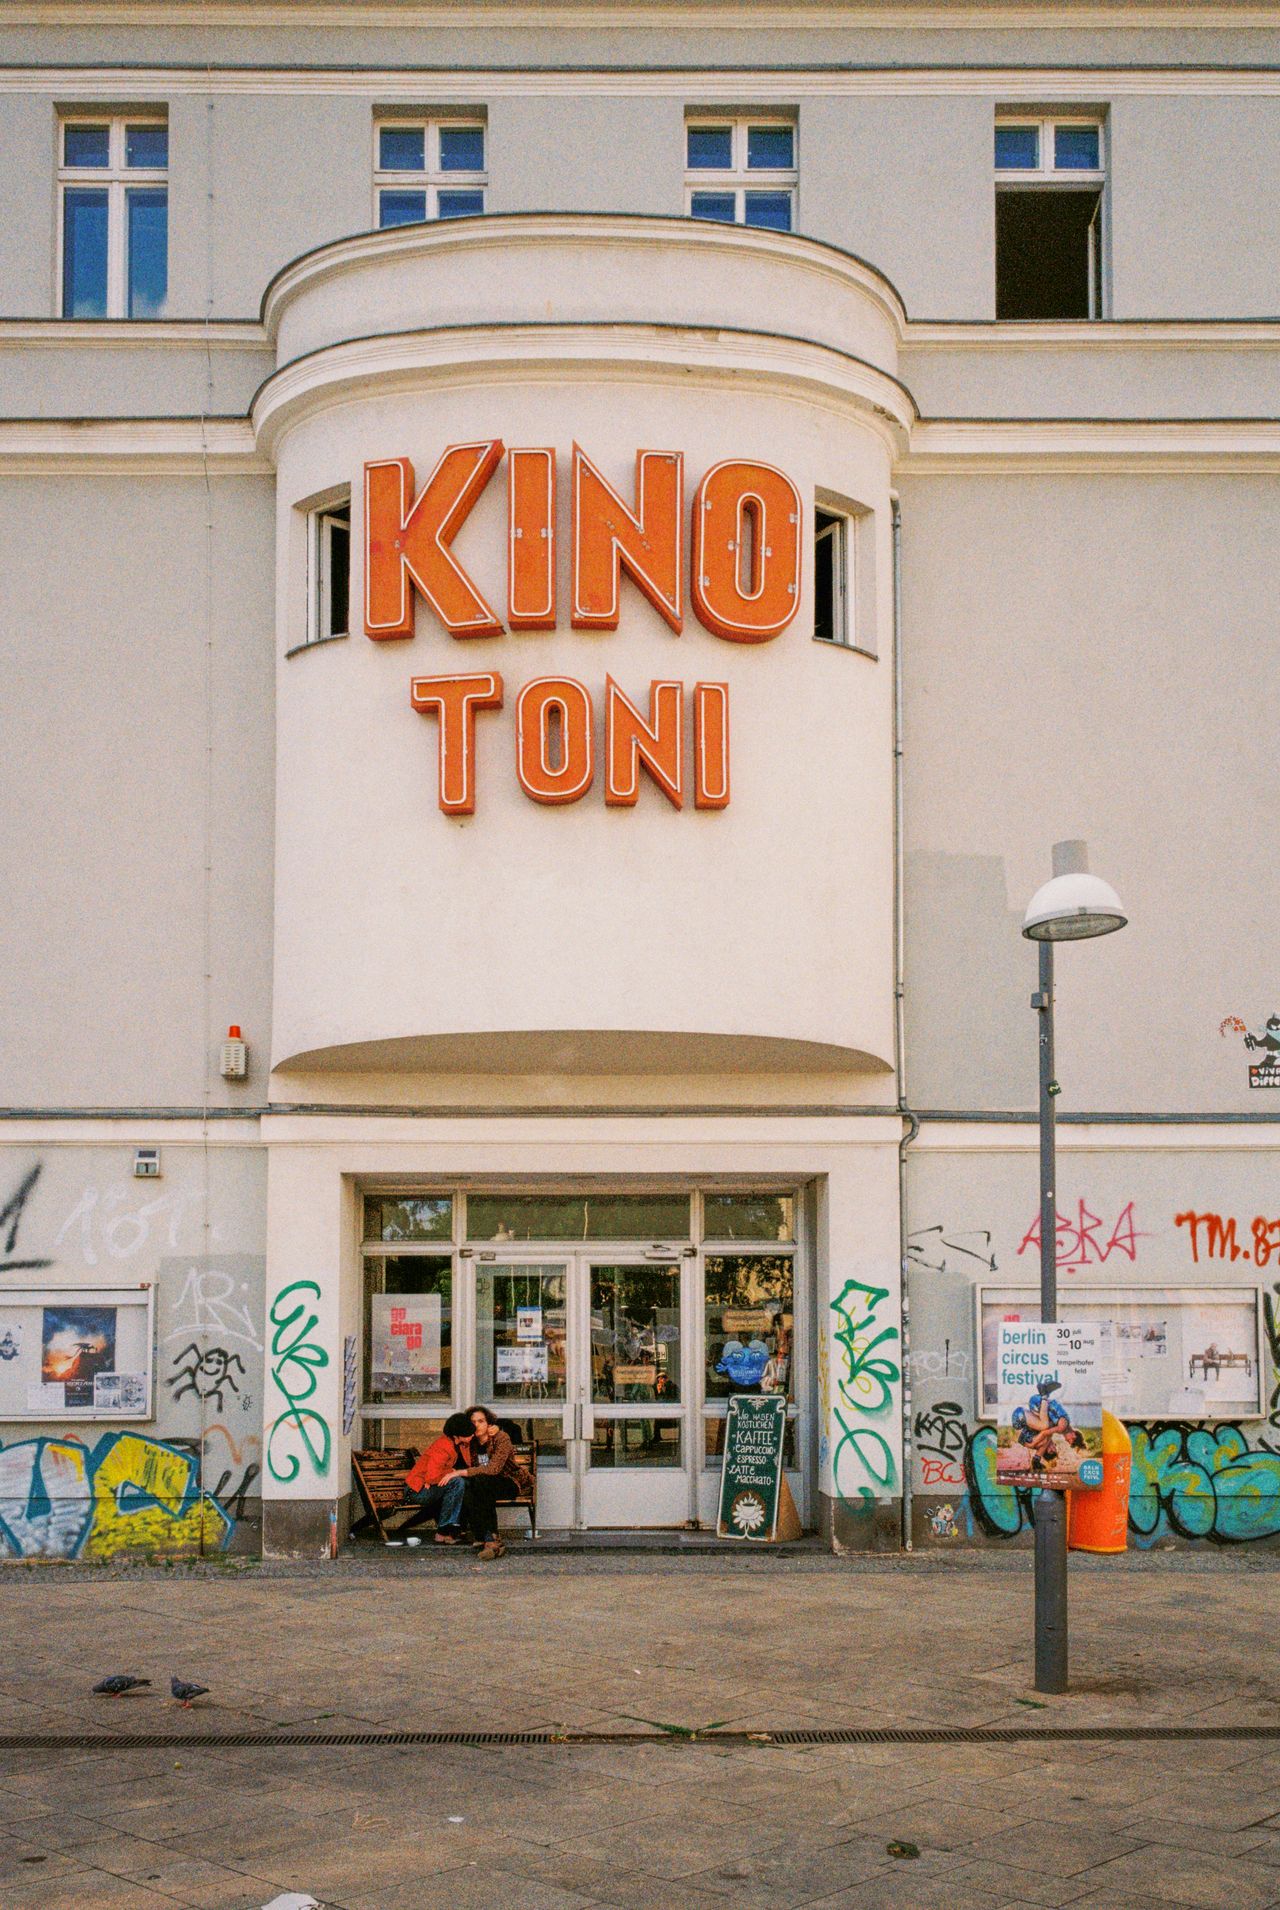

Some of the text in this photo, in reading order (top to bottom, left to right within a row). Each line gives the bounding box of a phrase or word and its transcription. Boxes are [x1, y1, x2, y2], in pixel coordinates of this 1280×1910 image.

[364, 438, 803, 644] KINO
[411, 672, 730, 816] TONI
[391, 1307, 406, 1321] go
[390, 1322, 422, 1335] clara
[1056, 1328, 1070, 1338] 30
[407, 1336, 422, 1350] go
[1002, 1329, 1046, 1344] berlin
[1002, 1349, 1049, 1365] circus
[1002, 1369, 1058, 1385] festival
[736, 1430, 774, 1445] KAFFEE
